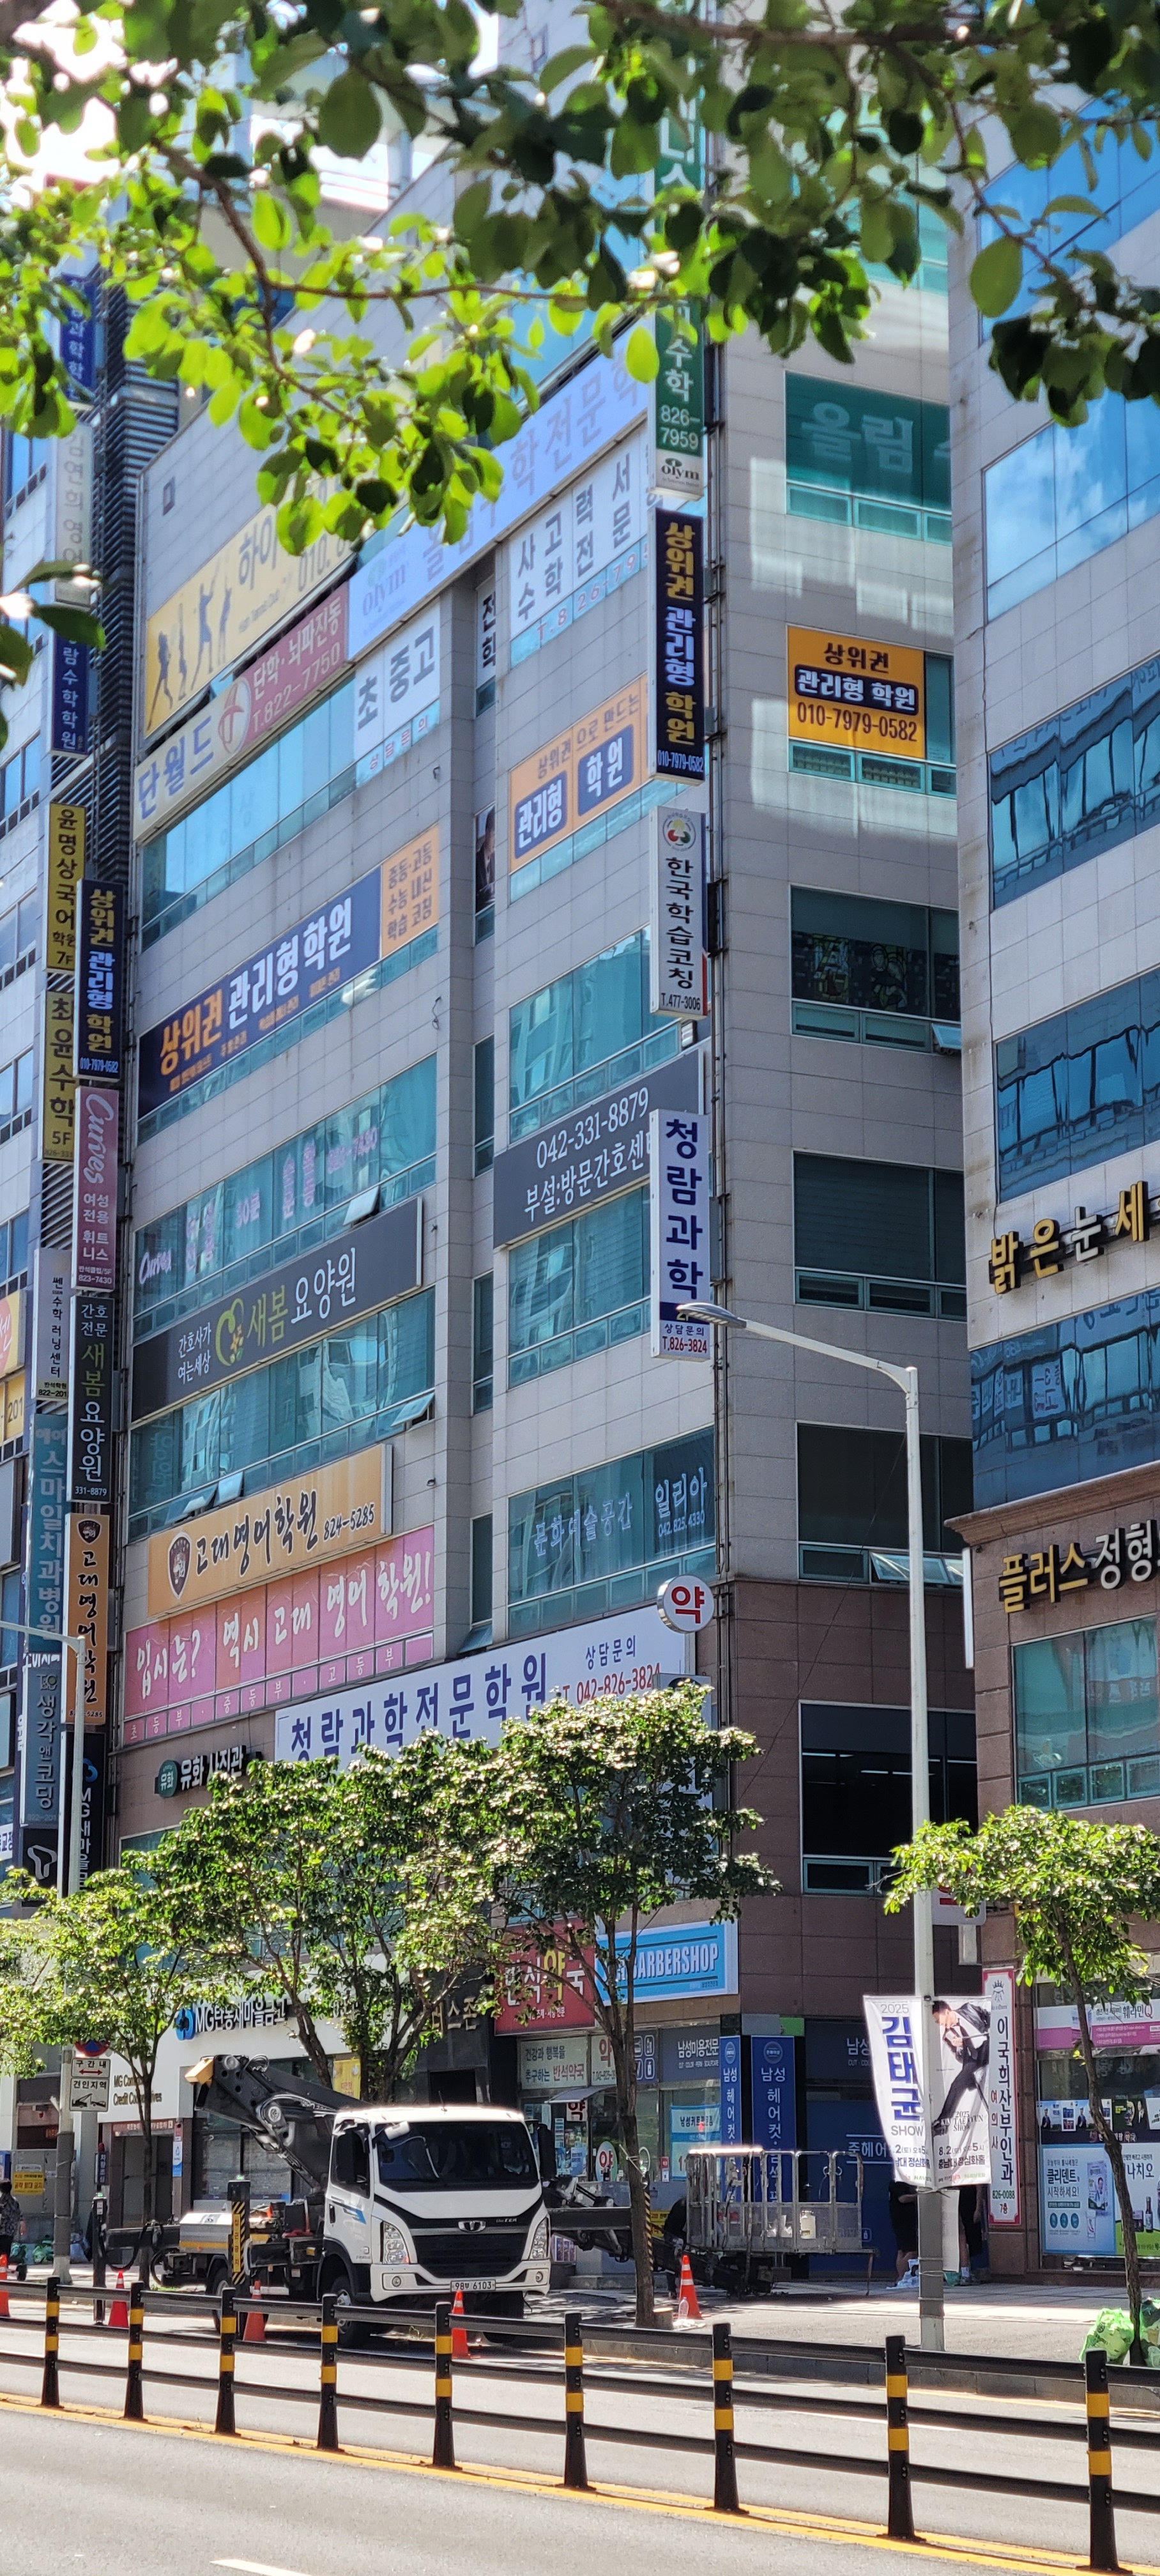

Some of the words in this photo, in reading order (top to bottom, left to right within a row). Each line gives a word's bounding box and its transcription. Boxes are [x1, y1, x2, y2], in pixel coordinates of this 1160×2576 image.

[660, 427, 699, 450] 7959
[801, 401, 914, 474] 올림
[665, 522, 696, 601] 상위권
[665, 606, 696, 686] 관리형
[824, 643, 889, 674] 상위권
[61, 639, 80, 749] 람수학학원
[797, 668, 866, 701] 관리형
[872, 684, 916, 712] 학원
[666, 692, 696, 746] 학원
[797, 702, 918, 742] 010-7979-0582
[138, 716, 214, 820] 단월드
[658, 749, 703, 772] 010-7979-0582
[518, 778, 563, 848] 관리형
[586, 737, 623, 798] 학원
[56, 809, 78, 930] 윤명상국어
[88, 889, 116, 947] 상위권
[666, 857, 694, 989] 한국학습코칭
[87, 951, 115, 1010] 관리형
[160, 988, 222, 1076] 상위권
[229, 934, 299, 1031] 관리형
[303, 897, 352, 971] 학원
[660, 992, 701, 1011] T.477-3006
[86, 1014, 114, 1054] 학원
[52, 1131, 71, 1146] 5F
[84, 1093, 114, 1184] Curves
[537, 1087, 649, 1169] 042-331-8879
[82, 1193, 109, 1208] 여성
[82, 1209, 109, 1225] 전용
[665, 1119, 703, 1301] 청람과학
[82, 1230, 109, 1246] 휘트
[82, 1247, 109, 1262] 니스
[78, 1275, 112, 1285] 823-7430
[247, 1284, 289, 1348] 새봄
[291, 1247, 356, 1324] 요양원
[52, 1296, 63, 1322] 수학
[81, 1304, 109, 1320] 간호
[81, 1321, 109, 1338] 전문
[178, 1322, 211, 1359] 간호사가
[662, 1336, 708, 1354] T.826-3824
[664, 1323, 705, 1337] 상담문의
[50, 1325, 63, 1378] 러닝센터
[75, 1485, 107, 1497] 331-8879
[655, 1467, 708, 1519] 일리아
[197, 1489, 317, 1577] 고대영어학원
[323, 1503, 375, 1541] 824-5285
[671, 1584, 705, 1624] 약
[137, 1630, 201, 1699] 입시는?
[223, 1612, 259, 1668] 역시
[275, 1601, 312, 1646] 고대
[327, 1570, 367, 1638] 영어
[378, 1551, 432, 1620] 학원!
[586, 1634, 636, 1671] 상담문의
[69, 1710, 103, 1718] 82-5285
[160, 1771, 174, 1791] 유화
[180, 1756, 204, 1791] 유화
[880, 2004, 909, 2014] 2025
[525, 2046, 544, 2062] 건강과
[546, 2044, 566, 2059] 행복을
[678, 2038, 719, 2059] 남성미용전문
[73, 2080, 107, 2090] 견인지역
[525, 2068, 551, 2082] 추구하는
[553, 2064, 584, 2082] 반석약국
[722, 2067, 738, 2083] 남성
[760, 2067, 786, 2083] 남성
[881, 2016, 920, 2121] 김태균
[767, 2087, 782, 2140] 헤어컷
[990, 2089, 999, 2150] 여의사
[996, 2016, 1014, 2188] 이국희산부인과
[890, 2125, 924, 2136] SHOW
[992, 2189, 1015, 2200] 826-0088
[999, 2203, 1008, 2214] 7층
[1047, 2186, 1080, 2198] 시작하세요!
[454, 2282, 470, 2291] 98부
[473, 2281, 492, 2290] 6103
